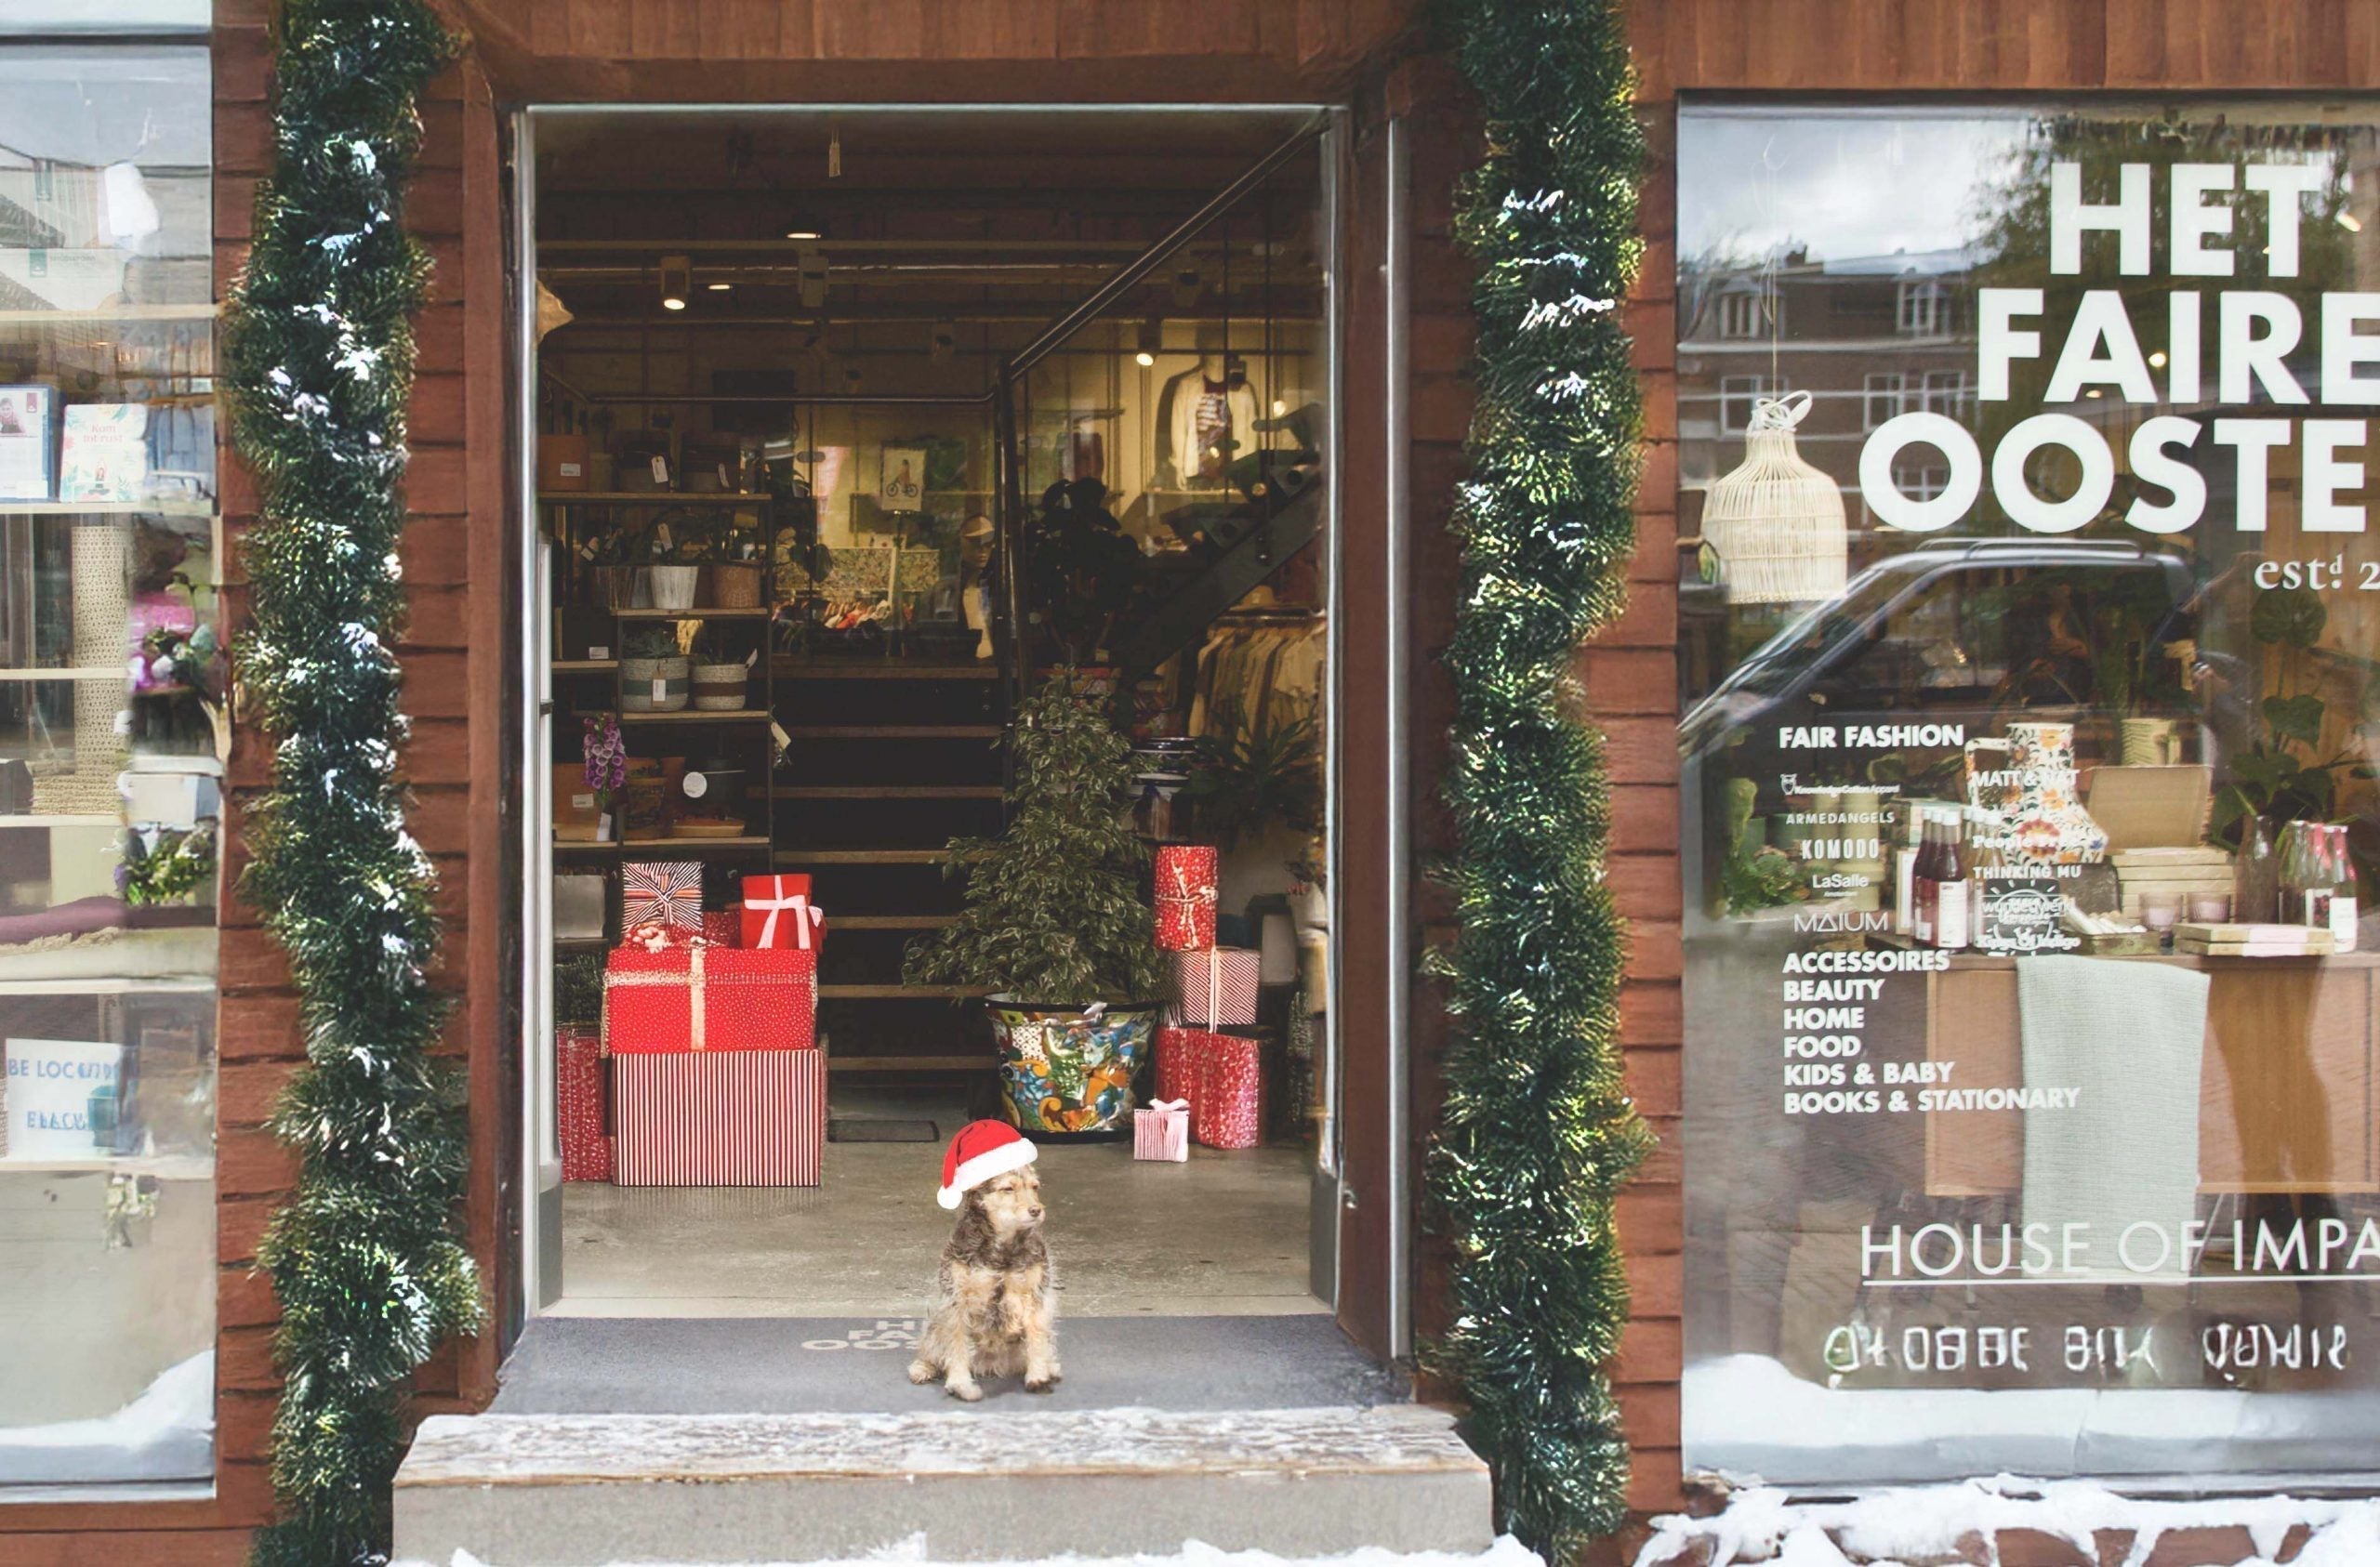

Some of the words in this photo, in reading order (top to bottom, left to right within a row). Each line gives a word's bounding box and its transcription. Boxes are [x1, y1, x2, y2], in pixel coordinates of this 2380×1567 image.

[2050, 163, 2321, 277] HET
[1978, 288, 2380, 405] FAIRE
[1779, 726, 1837, 748] FAIR
[1844, 724, 1964, 746] FASHION
[1972, 770, 2022, 786] MATT
[1786, 811, 1896, 824] ARMEDANGELS
[1802, 837, 1879, 860] KOMODO
[1972, 835, 2033, 850] People
[1812, 874, 1870, 889] LaSalle
[1973, 865, 2052, 878] THINKING
[2057, 864, 2082, 877] MU
[1782, 950, 1950, 973] ACCESSOIRES
[1783, 979, 1885, 1002] BEAUTY
[1783, 1007, 1865, 1030] HOME
[1783, 1035, 1861, 1058] FOOD
[8, 1059, 29, 1076] BE
[1783, 1063, 1846, 1086] KIDS
[1853, 1062, 1876, 1086] &
[1884, 1061, 1955, 1084] BABY
[1784, 1090, 1881, 1114] BOOKS
[1887, 1090, 1910, 1113] &
[1917, 1086, 2082, 1112] STATIONARY
[1861, 1222, 2090, 1276] HOUSE
[2118, 1219, 2205, 1273] OF
